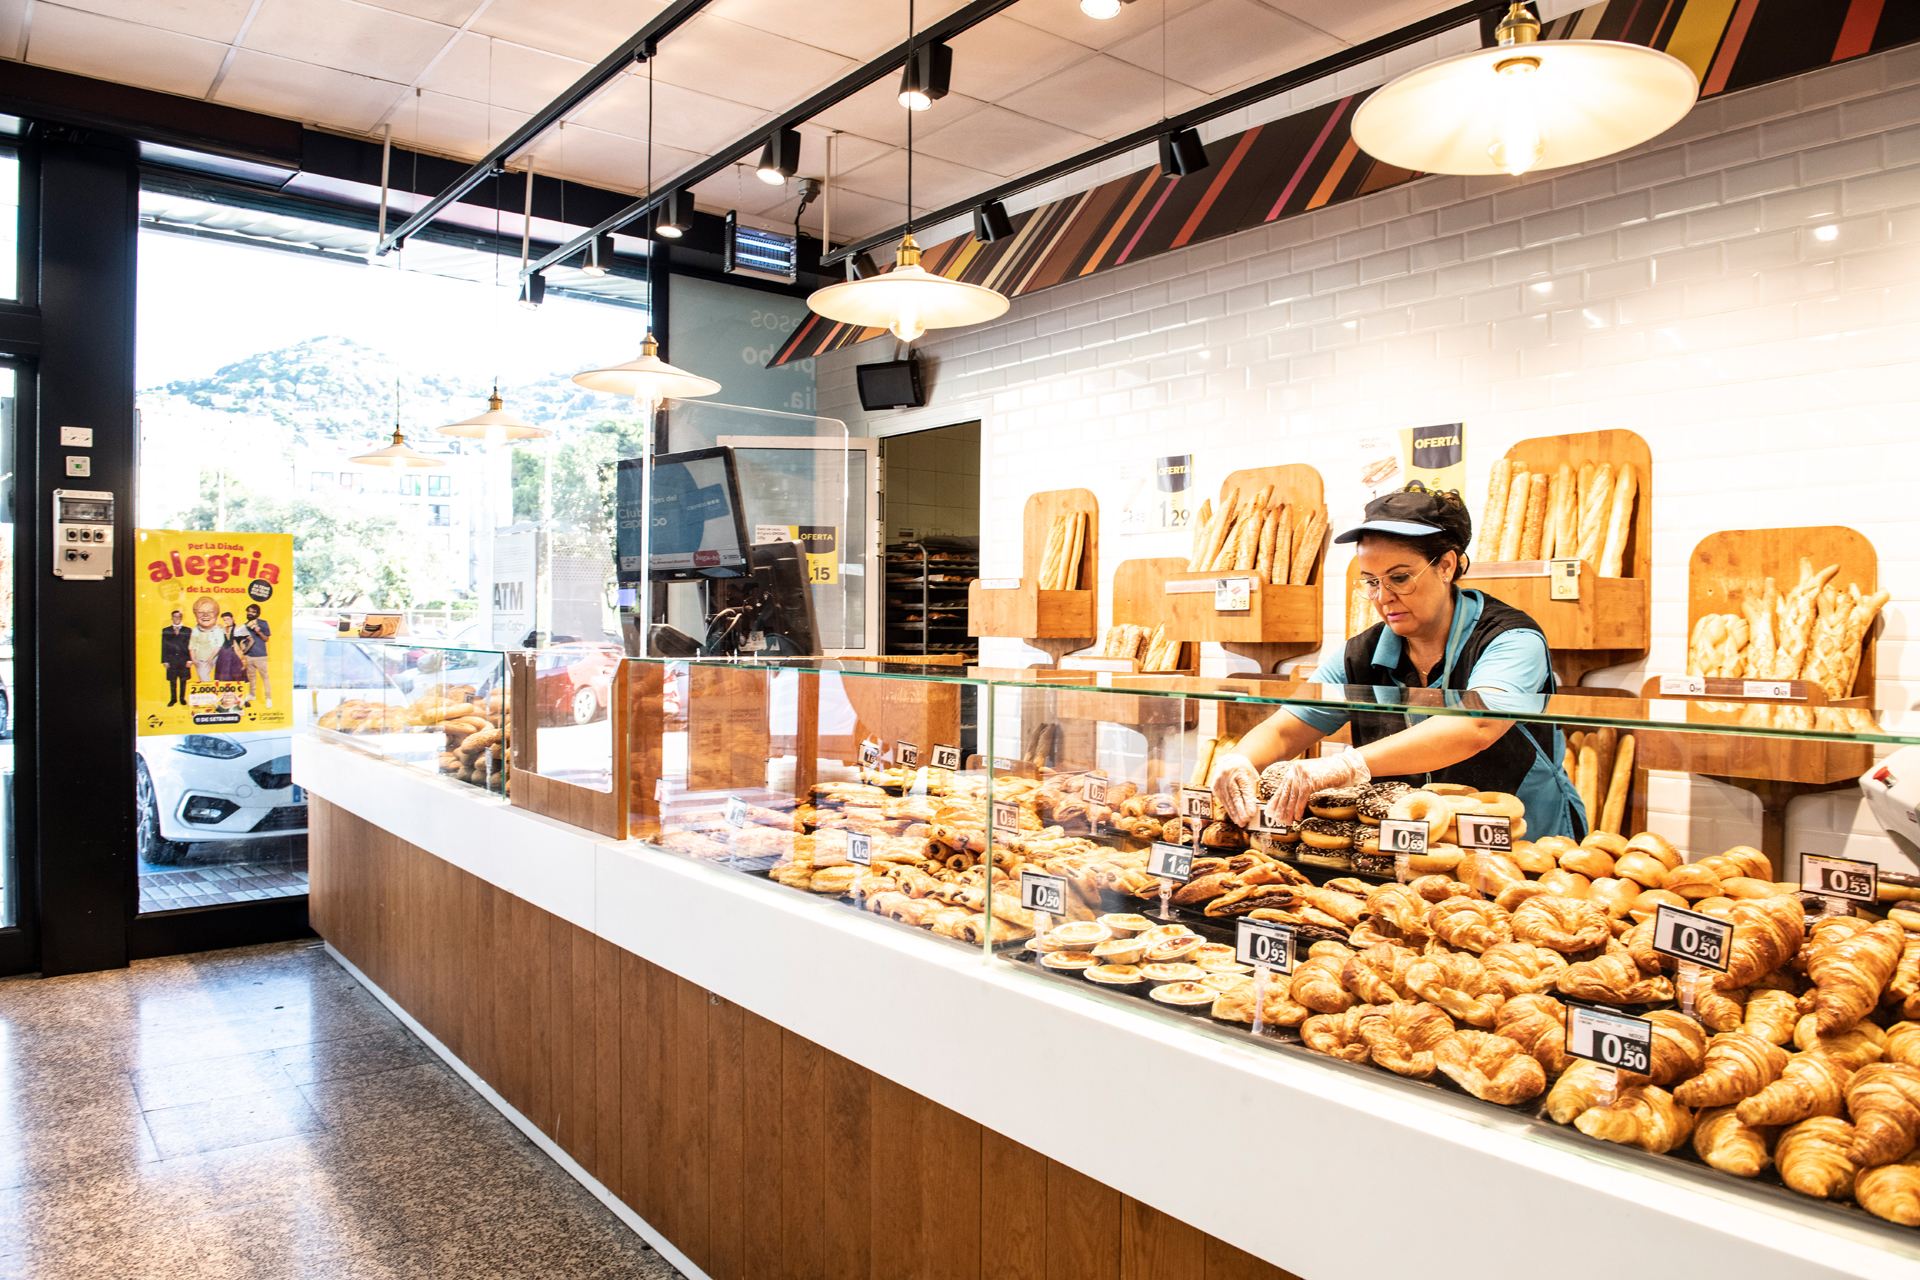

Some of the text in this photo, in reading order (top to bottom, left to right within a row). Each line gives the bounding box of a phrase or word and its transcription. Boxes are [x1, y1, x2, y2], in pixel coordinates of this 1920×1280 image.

[1415, 436, 1460, 449] OFERTA
[1158, 465, 1191, 476] OFERTA
[1159, 501, 1191, 528] 1,29
[205, 542, 216, 550] La
[218, 543, 244, 551] Diada
[148, 550, 280, 585] alegria
[213, 586, 246, 594] Grossa
[494, 582, 523, 610] ATM
[191, 686, 236, 694] 2.000.000
[1398, 830, 1424, 850] 0,69
[1480, 825, 1509, 845] 0,85
[1168, 855, 1190, 875] 1,40
[1830, 871, 1870, 895] 0,53
[1036, 886, 1060, 908] 0,50
[1256, 936, 1286, 964] 0,93
[1680, 927, 1720, 960] 0,50
